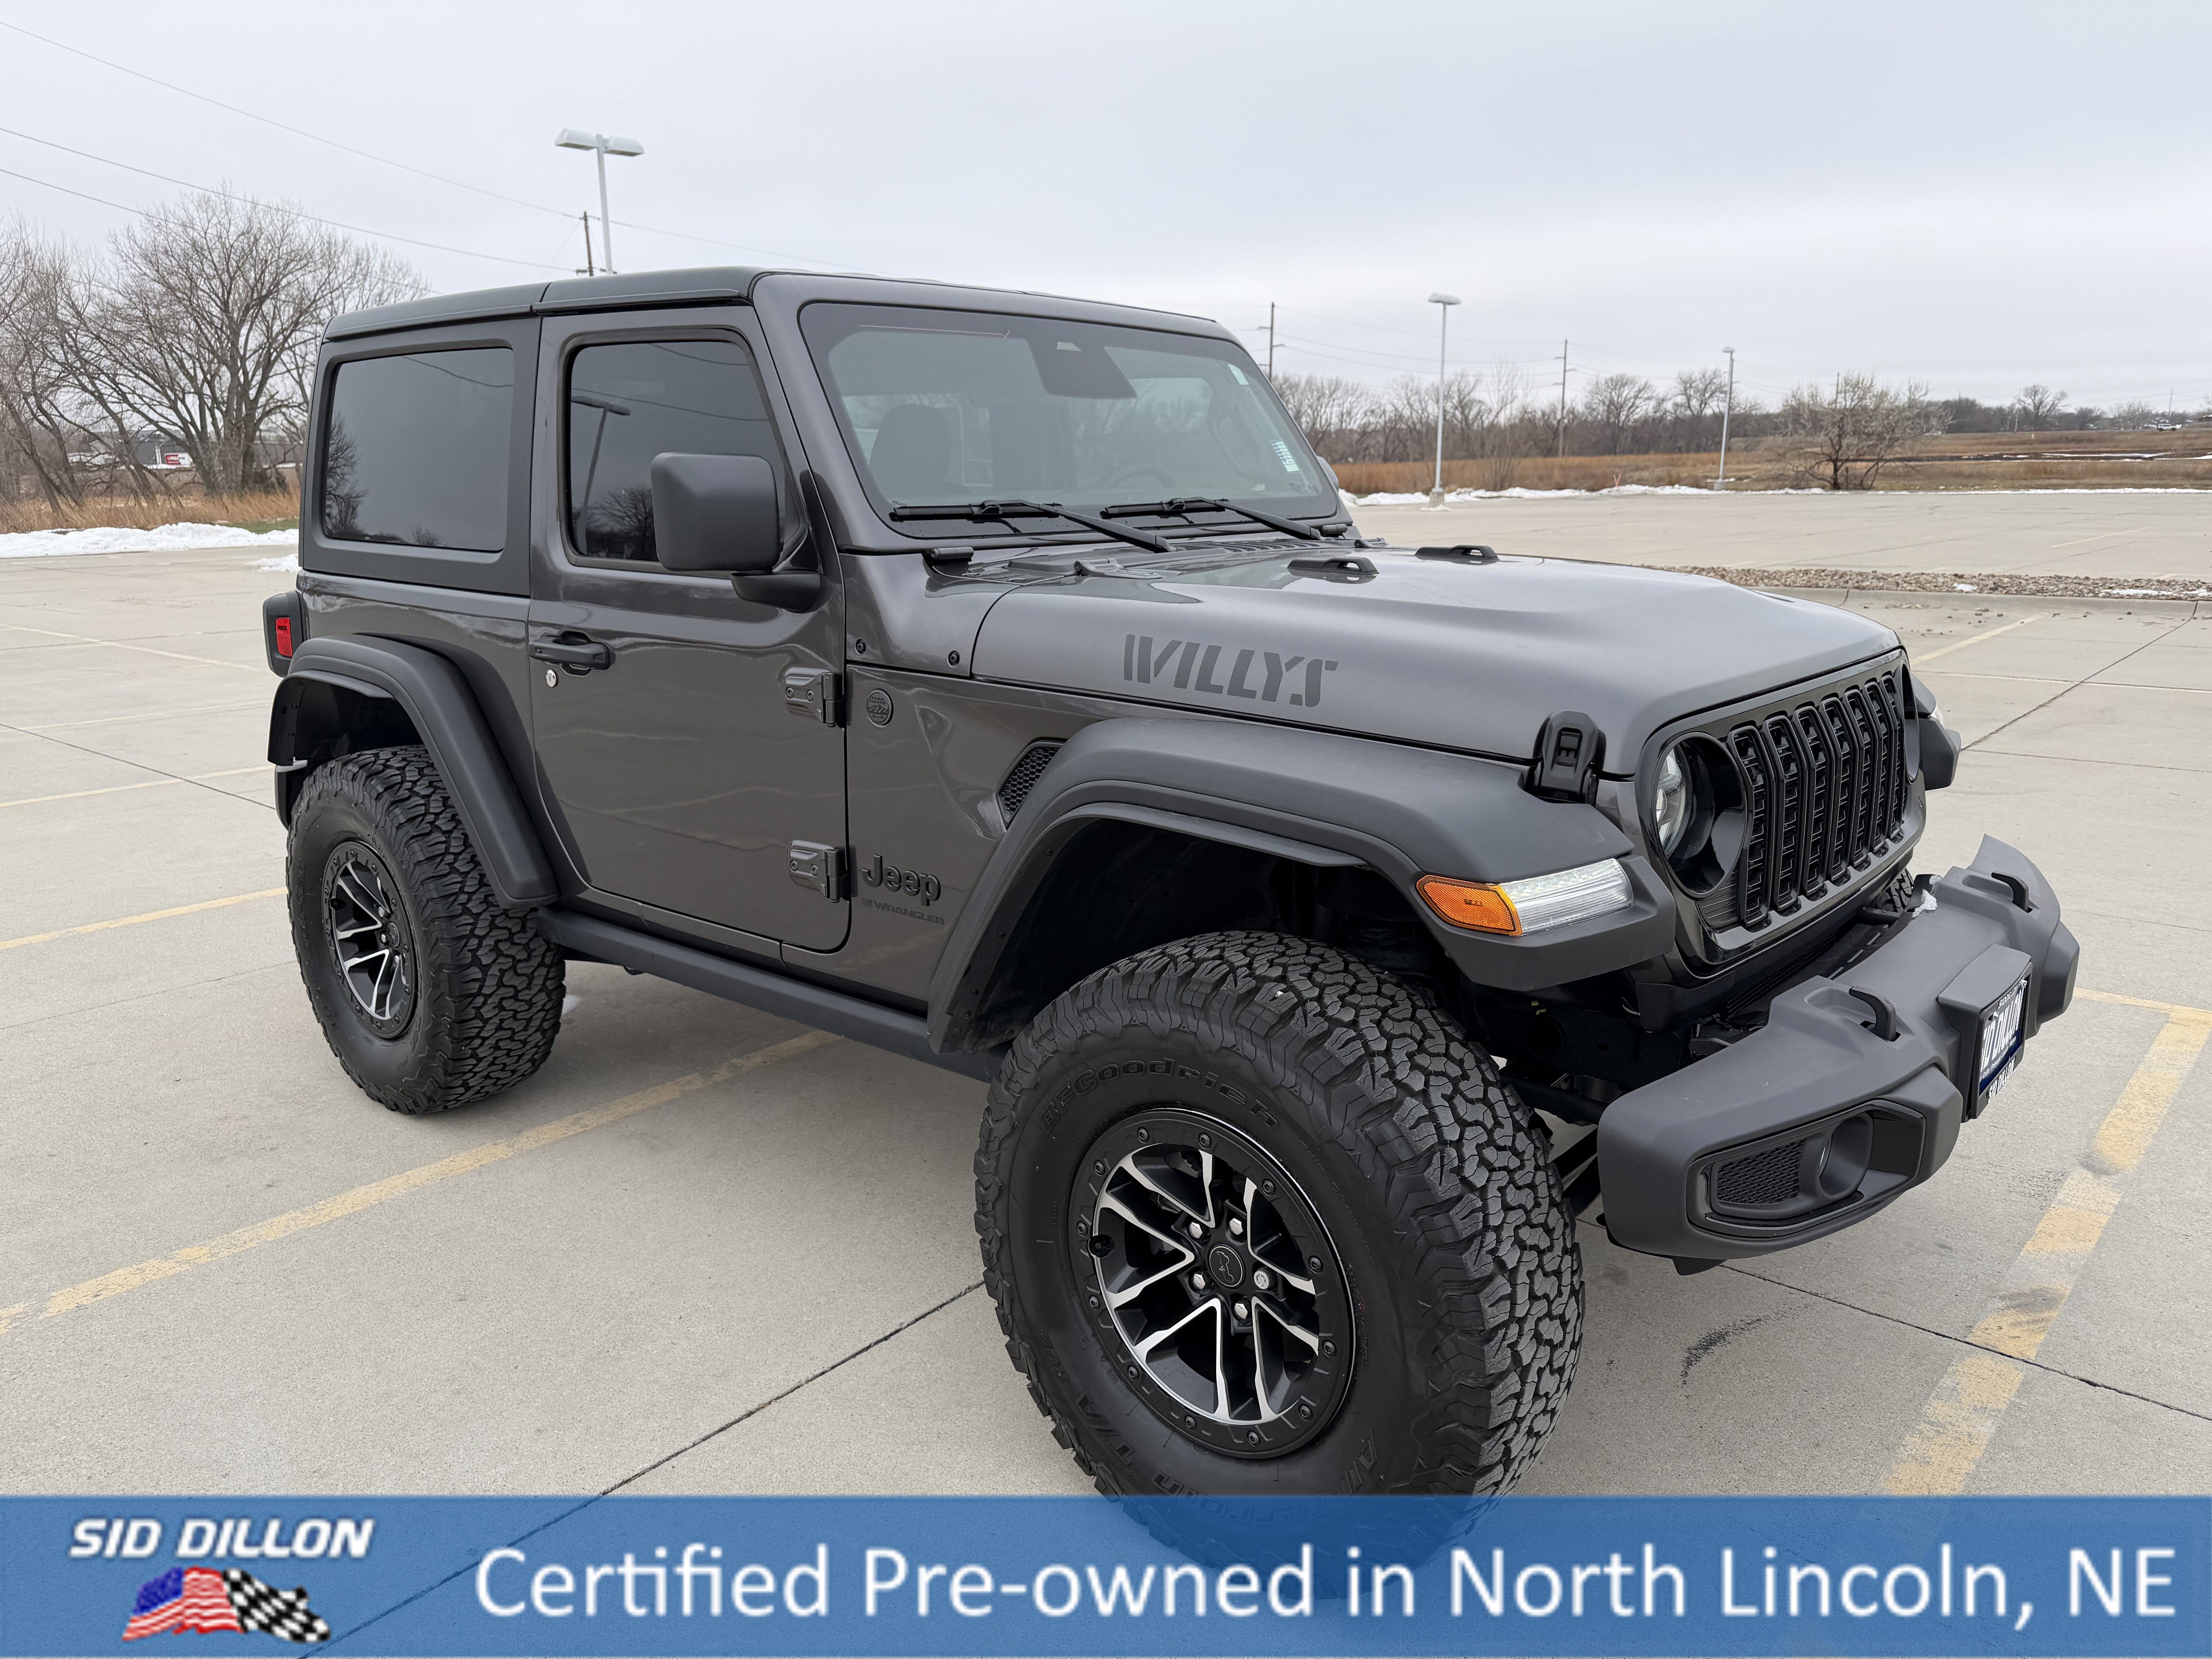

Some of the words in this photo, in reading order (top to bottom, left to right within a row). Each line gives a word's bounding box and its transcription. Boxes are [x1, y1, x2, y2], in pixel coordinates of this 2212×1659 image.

[1123, 634, 1339, 708] WILLYS
[862, 854, 941, 907] Jeep
[873, 900, 945, 926] WRANGLER
[1992, 986, 2024, 1061] DILLON
[1038, 1058, 1279, 1133] BFGoodrich
